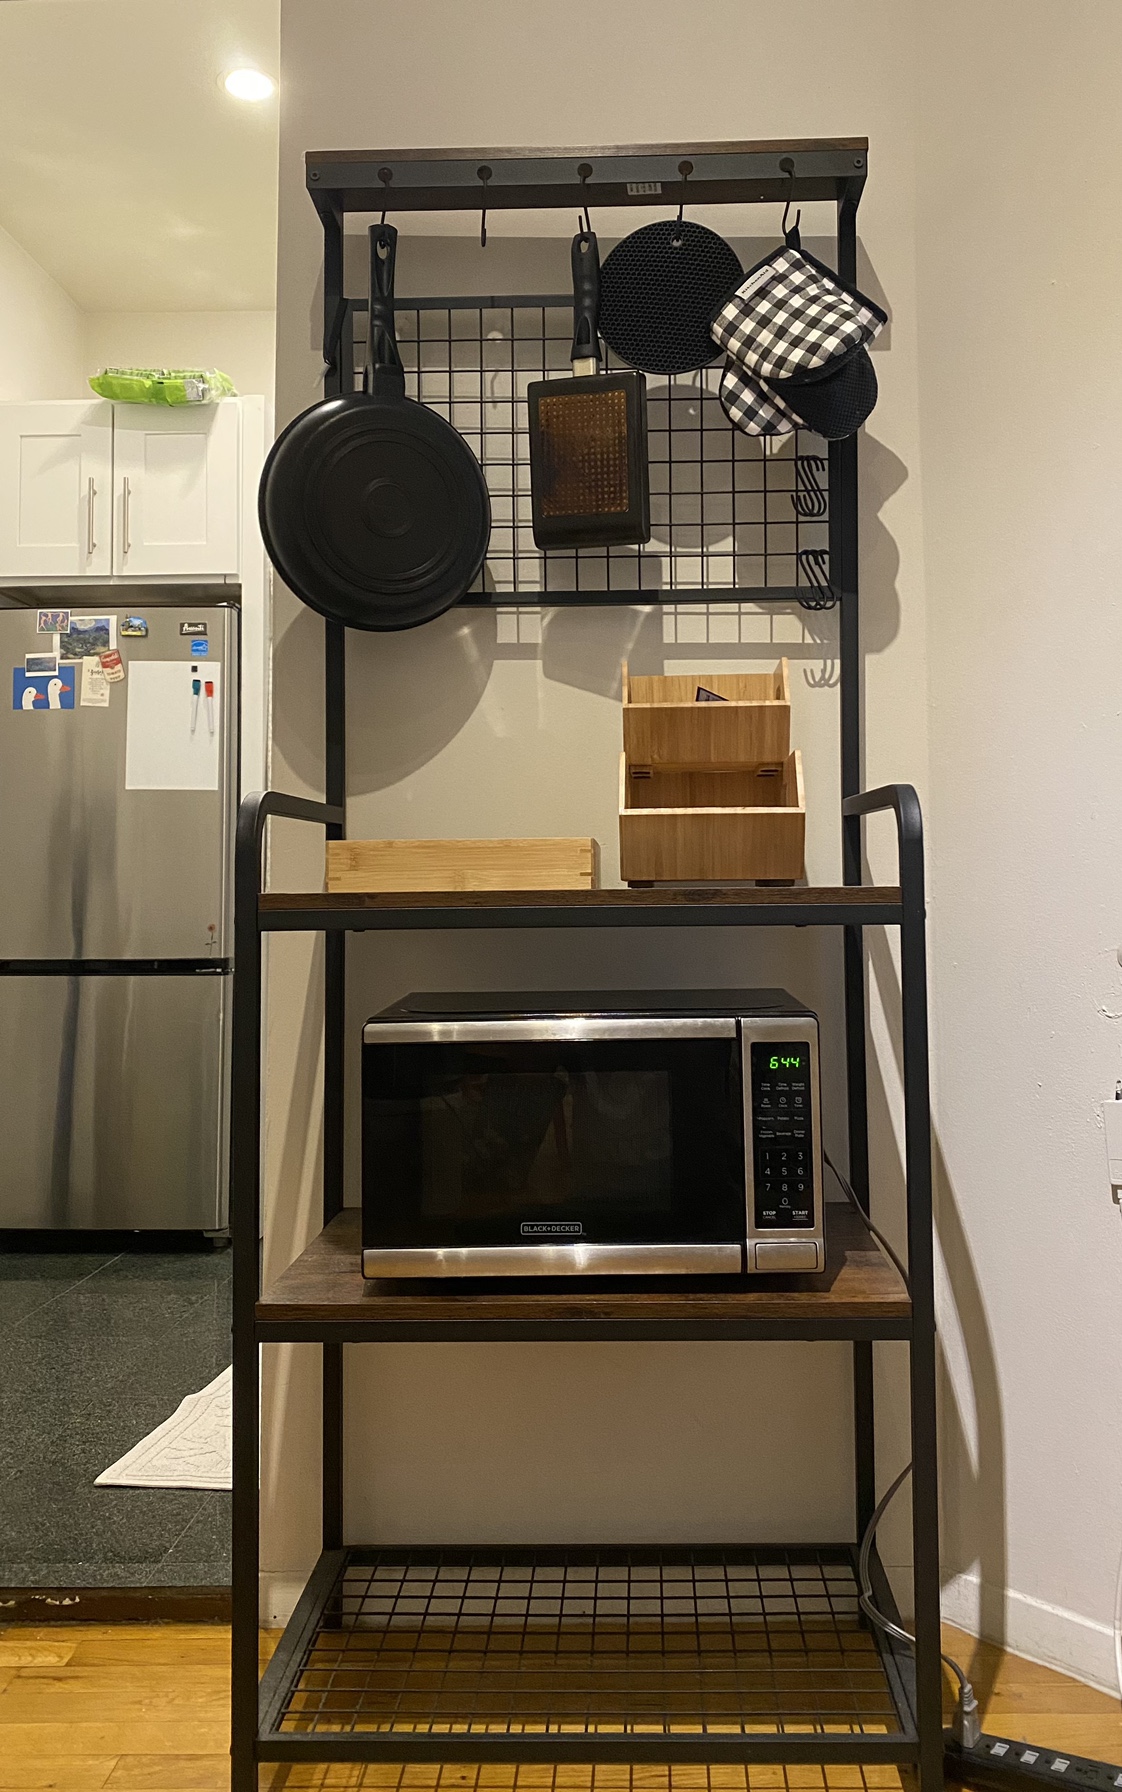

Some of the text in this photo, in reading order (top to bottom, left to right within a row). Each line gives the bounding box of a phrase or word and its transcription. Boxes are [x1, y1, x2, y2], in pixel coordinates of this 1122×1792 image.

[741, 268, 769, 294] KitchenAid
[765, 1152, 804, 1160] 1 2 3
[764, 1167, 804, 1176] 4 5 6
[765, 1183, 804, 1191] 7 8 9
